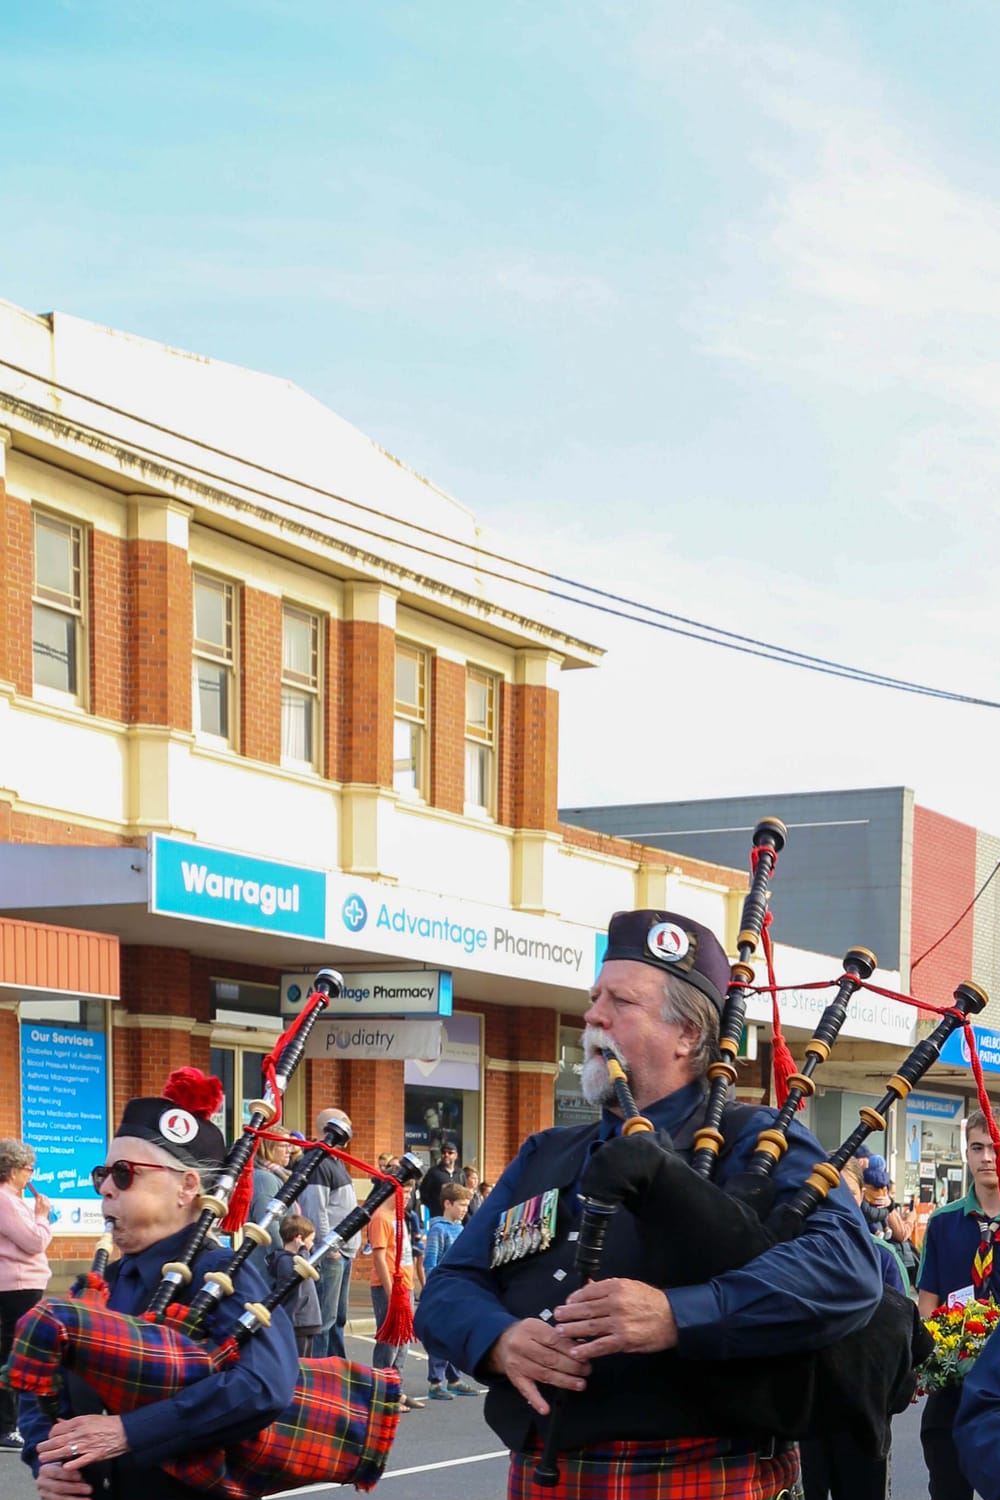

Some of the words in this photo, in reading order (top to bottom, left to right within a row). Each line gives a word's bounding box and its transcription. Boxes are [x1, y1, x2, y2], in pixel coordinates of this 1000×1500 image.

[181, 861, 299, 915] Warragul
[376, 904, 487, 953] Advantage
[494, 927, 582, 971] Pharmacy
[373, 986, 434, 1000] Pharmacy
[791, 988, 829, 1014] Street
[846, 1002, 877, 1025] edical
[880, 1007, 910, 1030] Clinic
[31, 1030, 50, 1042] Our
[52, 1032, 94, 1047] Services
[27, 1059, 44, 1067] Blood
[45, 1061, 68, 1069] Pressure
[70, 1063, 100, 1074] Monitoring
[27, 1071, 49, 1080] Asthma
[50, 1073, 89, 1083] Management
[53, 1085, 76, 1096] Packing
[38, 1097, 61, 1107] Piercing
[46, 1110, 79, 1118] Medication
[80, 1111, 102, 1120] Reviews
[27, 1120, 48, 1129] Beauty
[27, 1133, 60, 1142] Fragrances
[61, 1134, 73, 1142] and
[75, 1135, 103, 1144] Cosmetics
[50, 1146, 75, 1154] Discount
